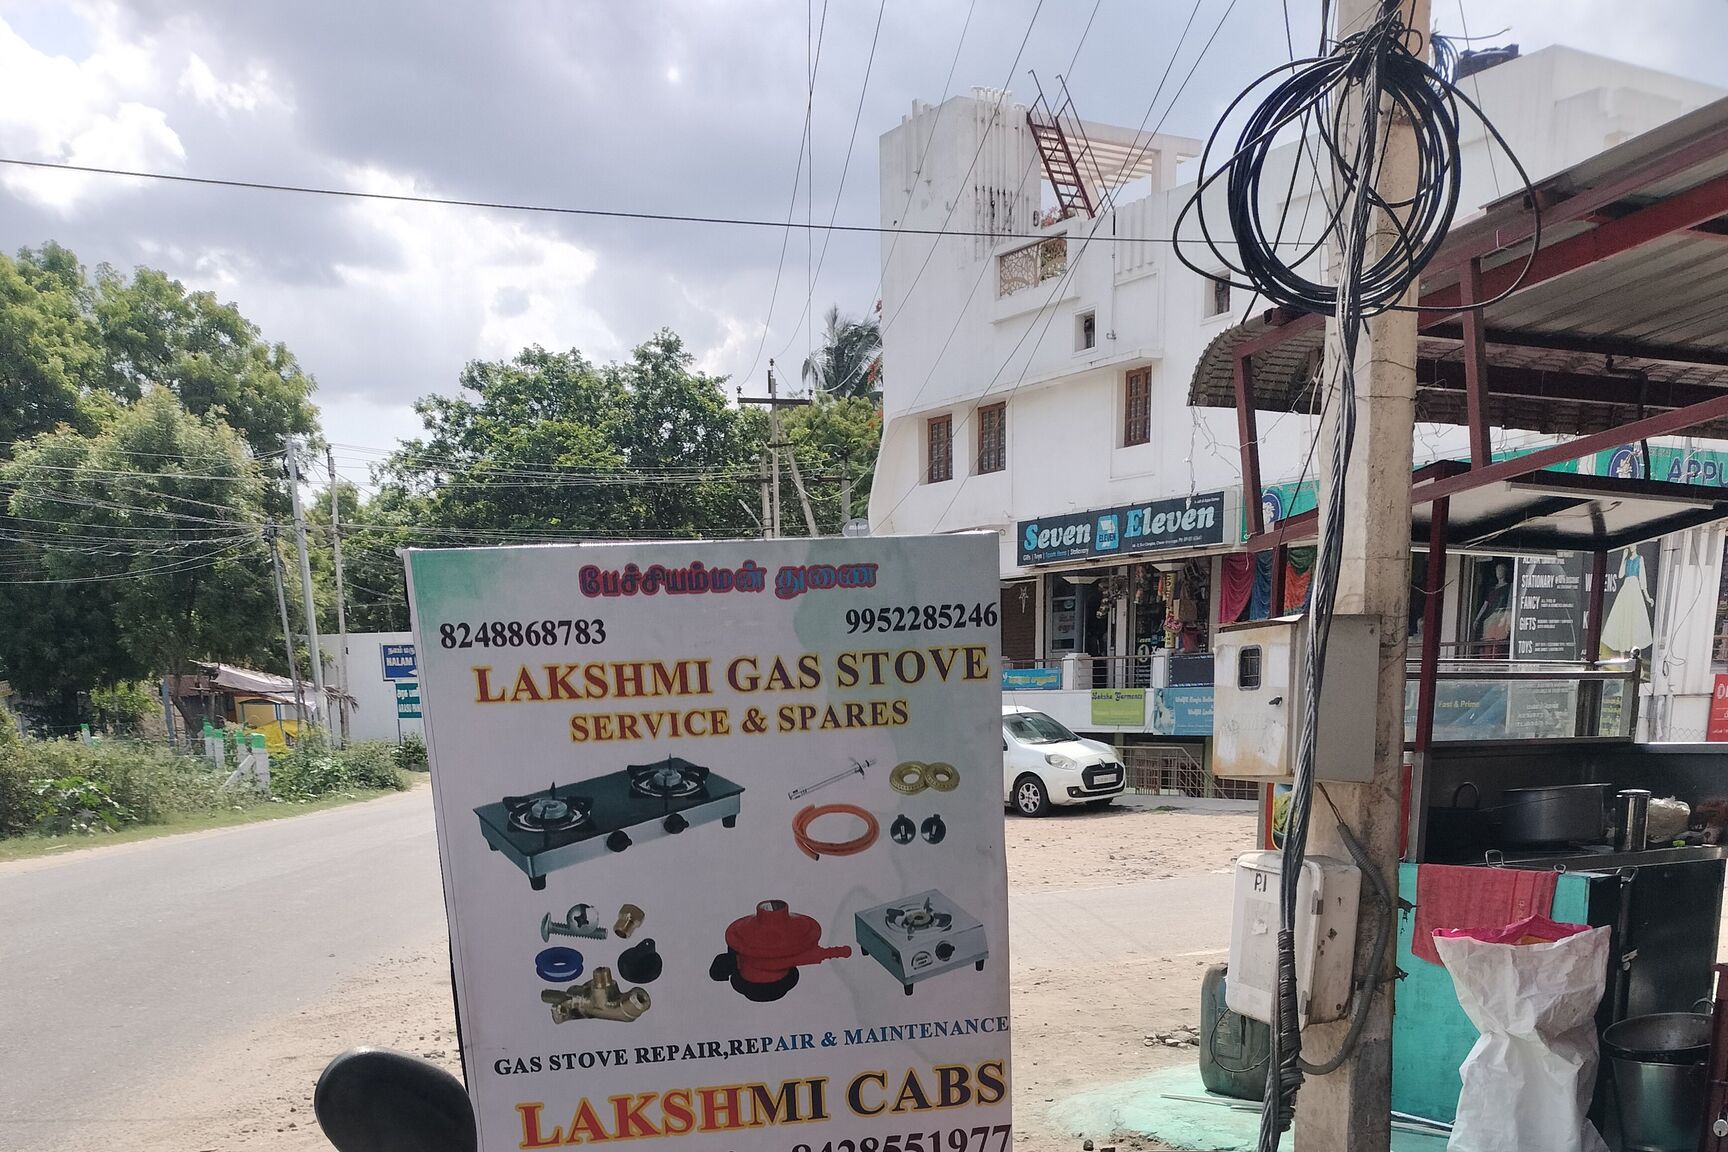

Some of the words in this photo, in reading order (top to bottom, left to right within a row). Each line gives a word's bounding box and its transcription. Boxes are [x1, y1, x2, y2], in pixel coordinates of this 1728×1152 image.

[1023, 523, 1091, 551] Seven
[1124, 505, 1216, 538] Eleven
[775, 563, 879, 600] துணை
[1521, 575, 1555, 588] STATIONARY
[845, 602, 997, 634] 9952285246
[1520, 596, 1540, 609] FANCY
[440, 619, 607, 649] 8248868783
[1519, 617, 1536, 630] GIFTS
[1518, 640, 1533, 653] TOYS
[472, 658, 712, 704] LAKSHMI
[727, 654, 821, 693] GAS
[837, 644, 991, 687] STOVE
[570, 707, 731, 743] SERVICE
[741, 711, 767, 734] &
[778, 699, 909, 732] SPARES
[494, 1056, 542, 1076] GAS
[549, 1050, 628, 1071] STOVE
[635, 1033, 815, 1065] REPAIR,REPAIR
[821, 1031, 837, 1048] &
[844, 1015, 1009, 1046] MAINTENANCE
[515, 1076, 831, 1152] LAKSHMI
[847, 1060, 1007, 1118] CABS
